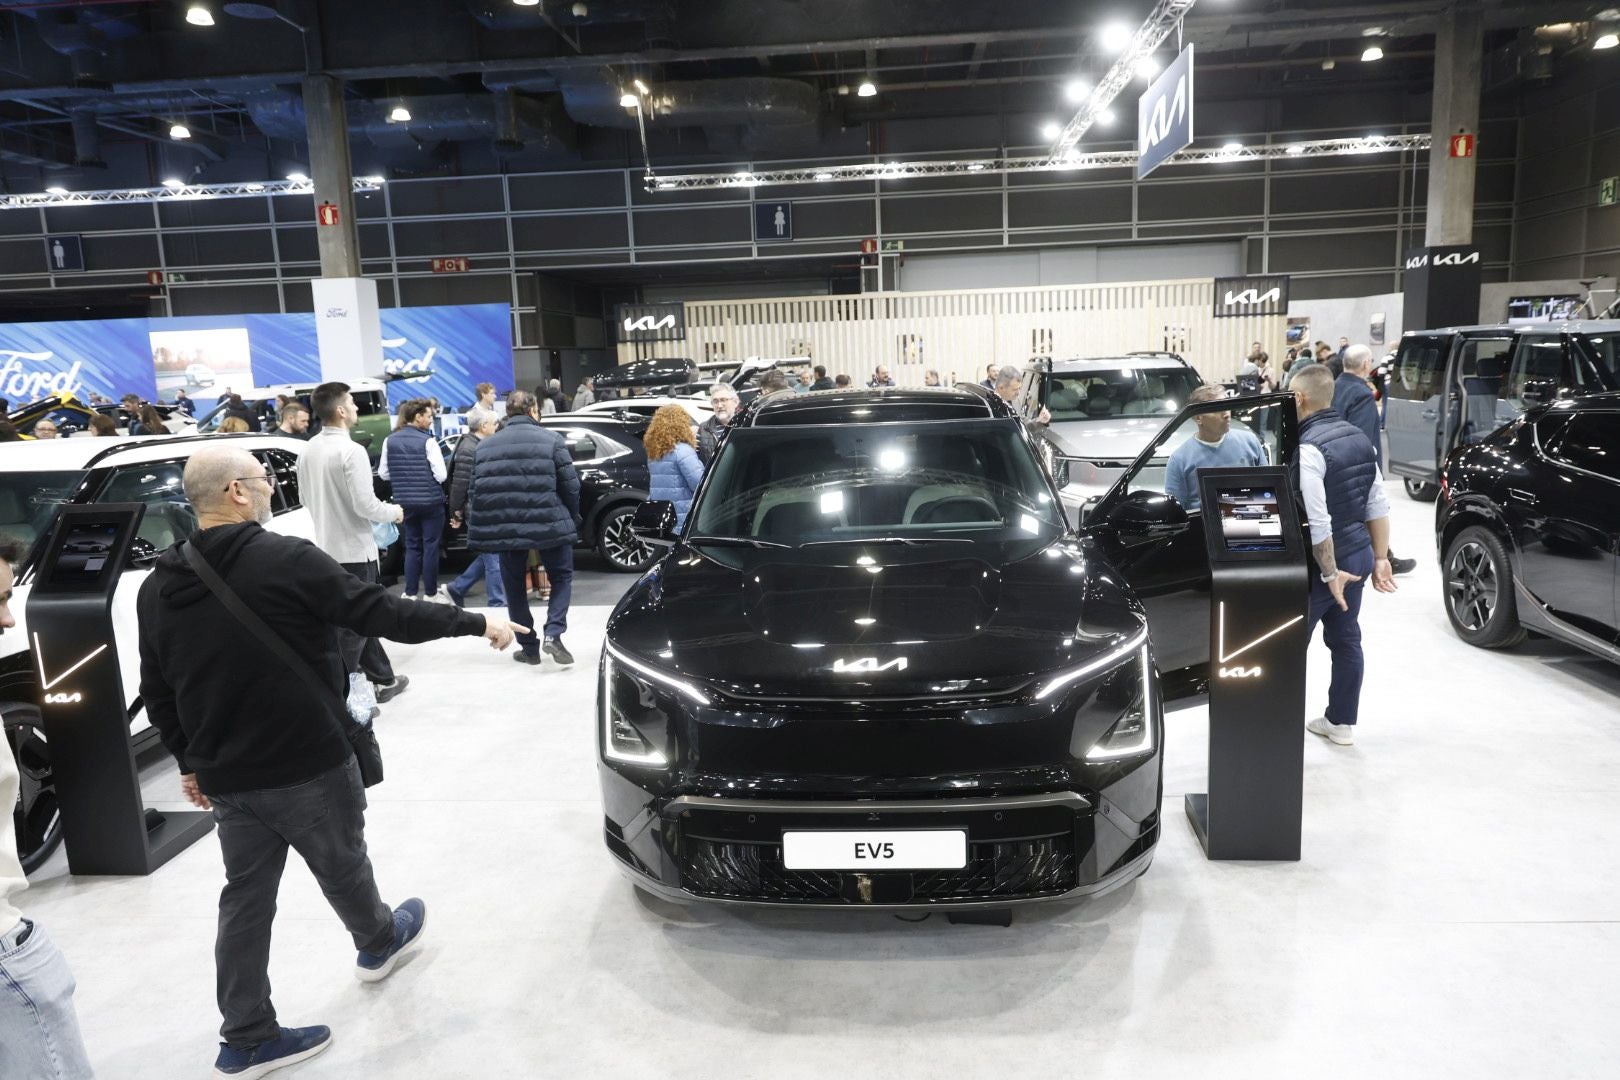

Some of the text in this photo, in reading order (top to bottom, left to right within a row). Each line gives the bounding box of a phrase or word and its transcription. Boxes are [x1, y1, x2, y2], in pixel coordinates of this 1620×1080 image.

[1140, 74, 1186, 157] KIA
[1406, 255, 1428, 270] KIA
[1433, 252, 1479, 266] KIA
[1225, 288, 1280, 305] KIA
[326, 308, 348, 318] Ford
[624, 315, 675, 331] KIA
[0, 350, 82, 398] Ford
[833, 657, 908, 672] KIA
[1219, 666, 1262, 678] KIA
[45, 692, 81, 704] KIA
[855, 843, 895, 859] EV5
